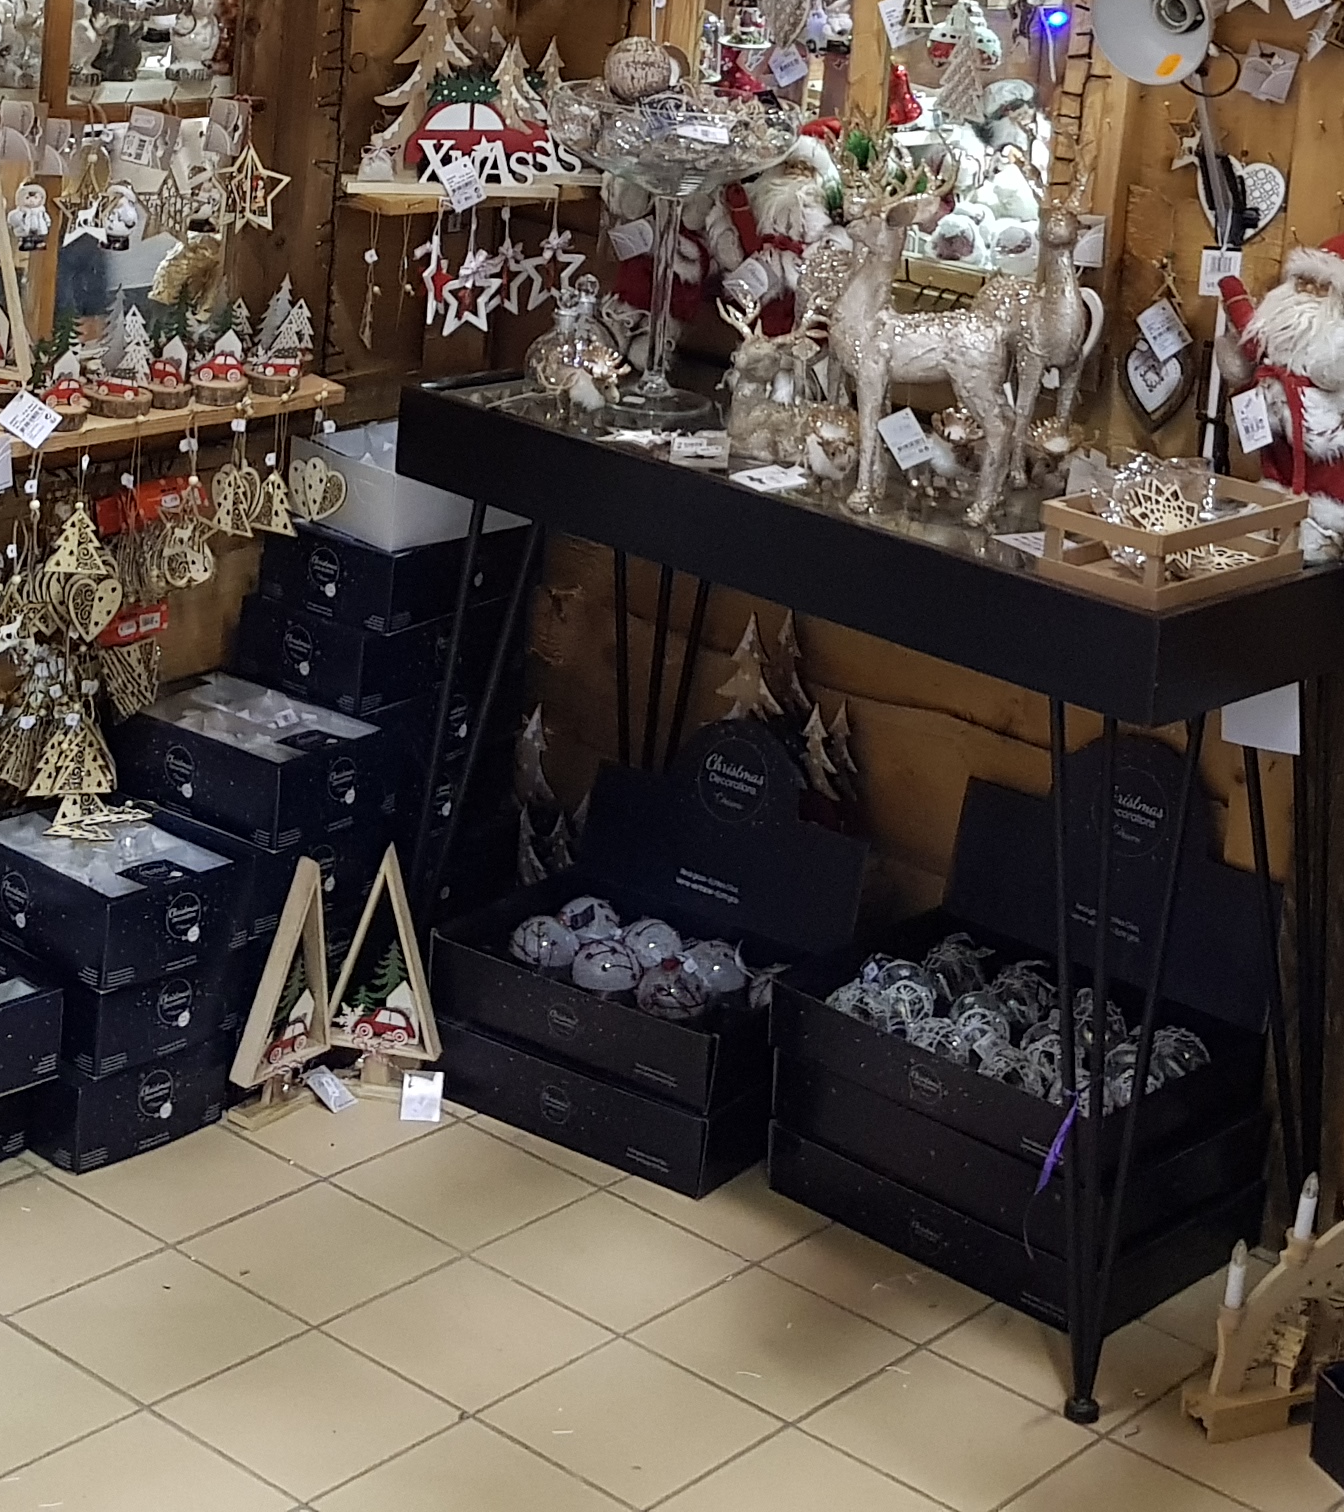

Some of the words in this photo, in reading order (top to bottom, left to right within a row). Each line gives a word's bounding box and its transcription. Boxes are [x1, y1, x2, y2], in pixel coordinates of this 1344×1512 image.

[706, 753, 764, 786] Christmas
[709, 772, 757, 795] Decorations
[1114, 786, 1164, 819] ristmas
